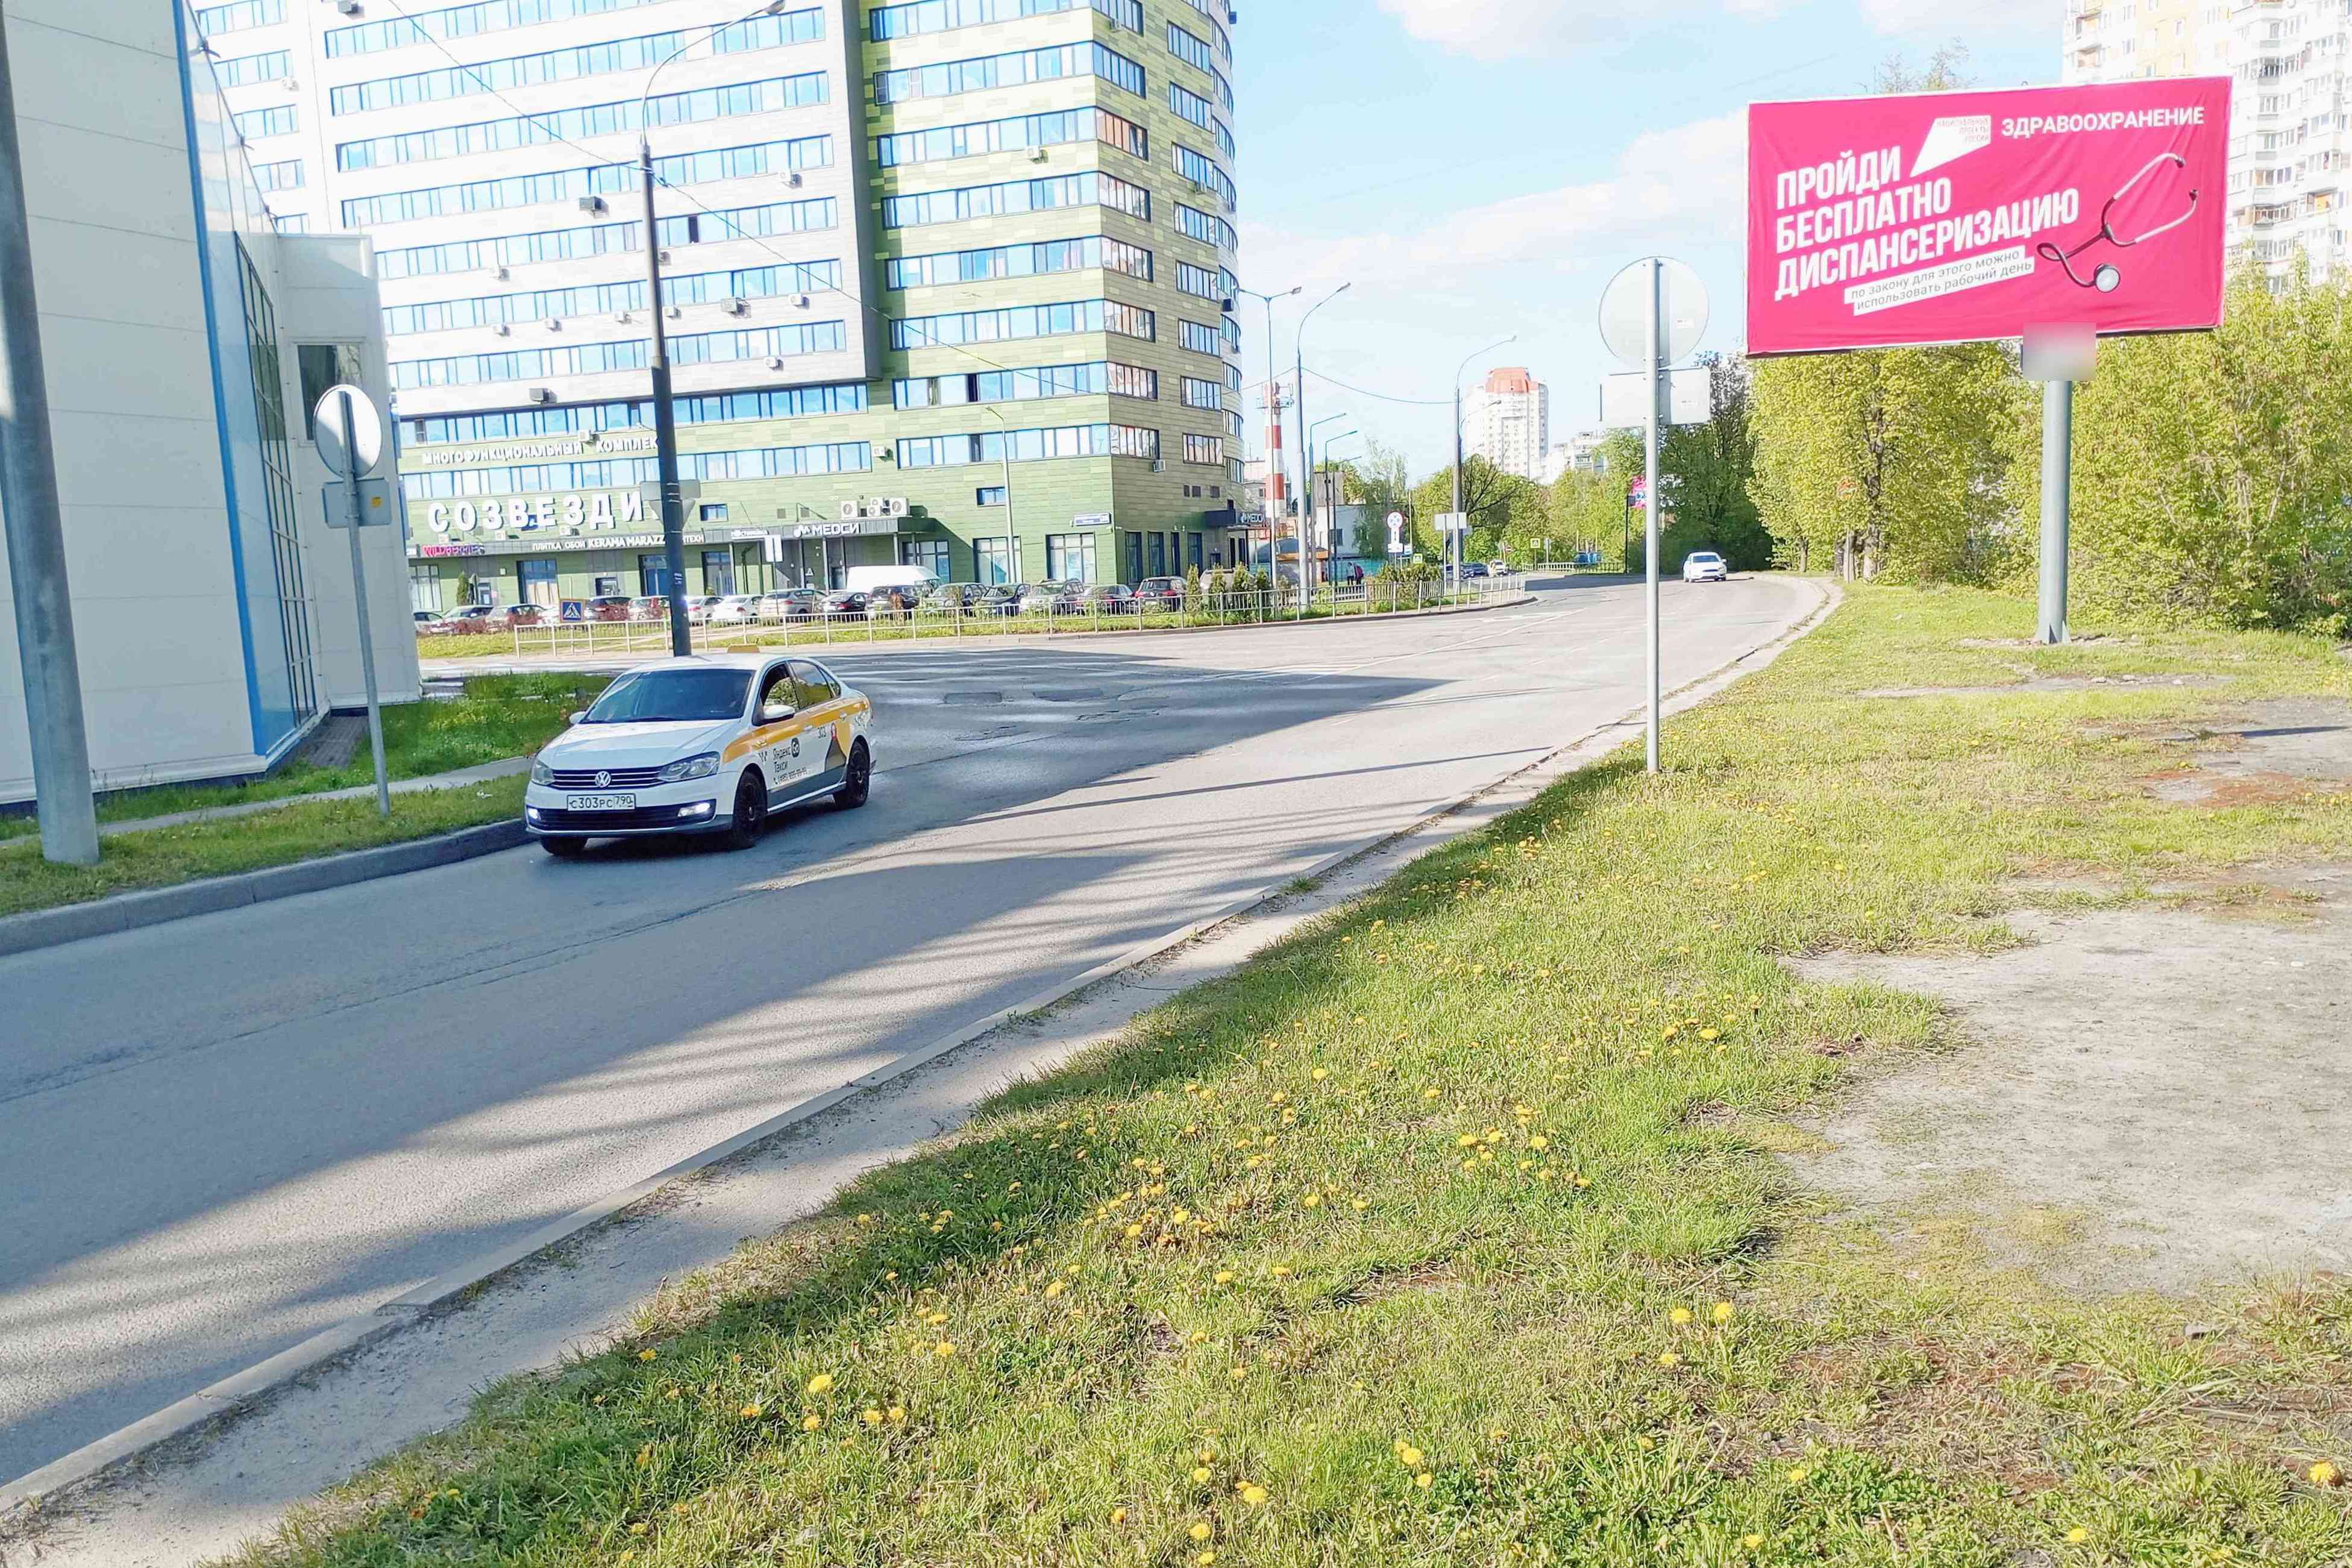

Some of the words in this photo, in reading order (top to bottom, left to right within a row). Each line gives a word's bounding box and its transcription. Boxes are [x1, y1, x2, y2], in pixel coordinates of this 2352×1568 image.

[2002, 107, 2204, 139] ЗДРАВООХРАНЕНИЕ
[1777, 146, 1901, 210] ПРОЙДИ
[1777, 177, 1951, 254] БЕСПЛАТНО
[1775, 188, 2079, 301] ДИСПАНСЕРИЗАЦИЮ
[1851, 289, 1865, 299] по
[1869, 277, 1909, 295] закону
[1912, 271, 1935, 286] для
[1938, 262, 1972, 278] этого
[1975, 250, 2019, 269] можно
[1857, 283, 1941, 310] использовать
[1944, 268, 1997, 292] рабочий
[2000, 262, 2032, 278] день
[422, 441, 583, 465] МНОГОФУНКЦИОНАЛЬНЫЙ
[596, 437, 658, 453] КОМПЛЕК
[427, 491, 659, 533] СОЗВЕЗДИ
[565, 541, 586, 549] ОБОИ
[588, 536, 626, 549] KERAMA
[627, 535, 665, 547] MARAZZ
